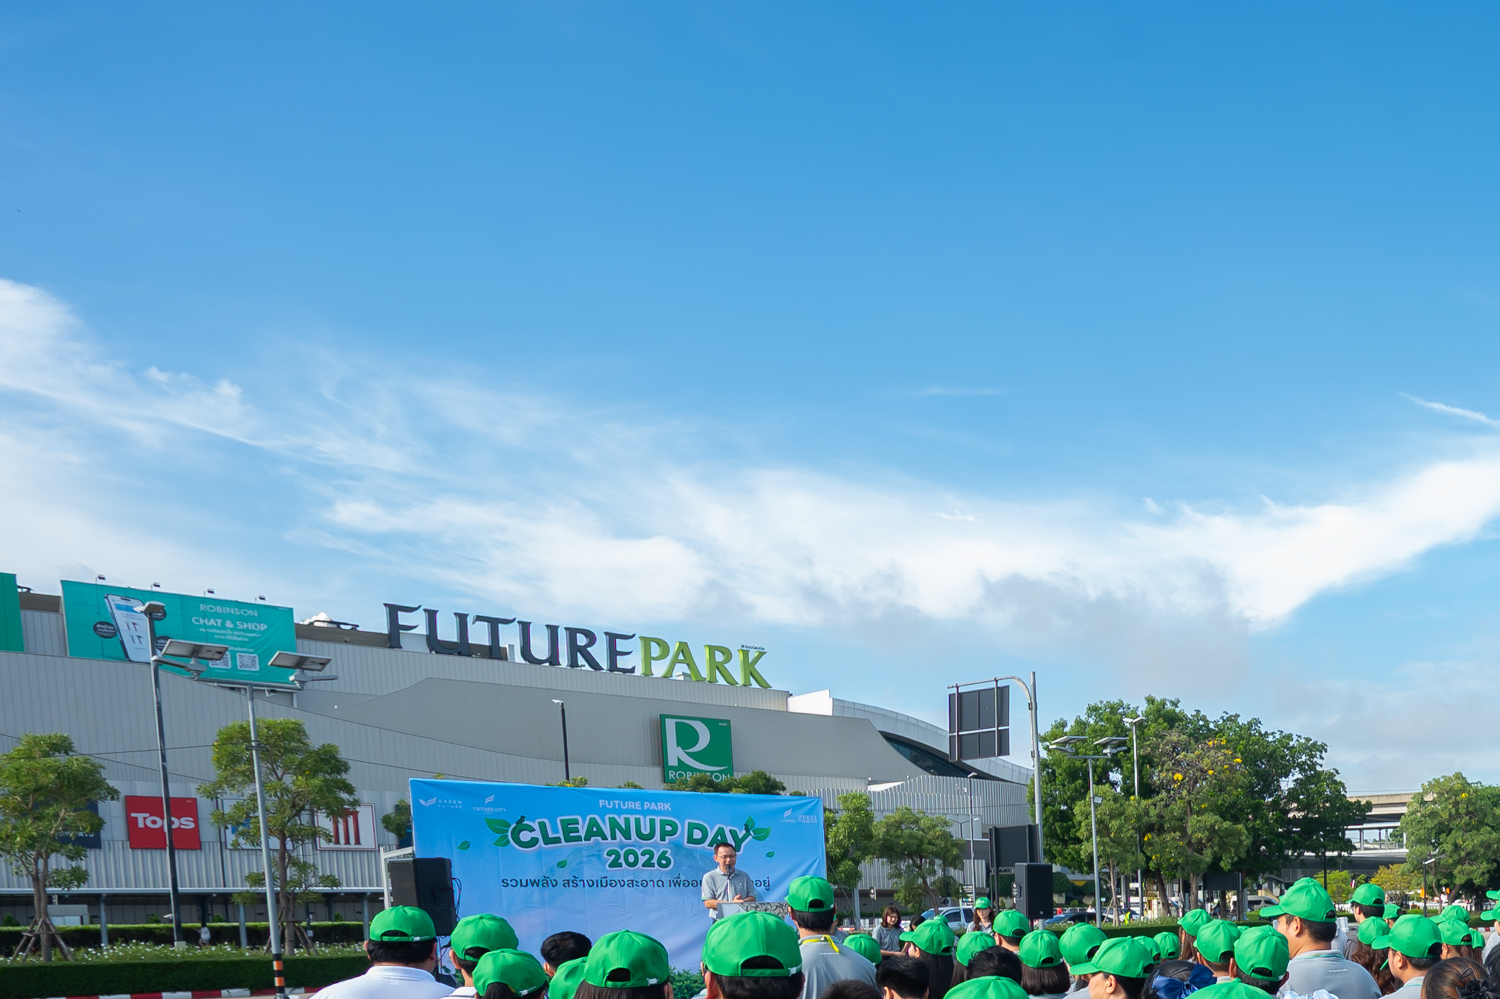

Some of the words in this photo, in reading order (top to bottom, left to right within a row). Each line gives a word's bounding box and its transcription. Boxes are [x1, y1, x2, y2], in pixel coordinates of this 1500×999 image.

[200, 604, 258, 616] ROBINSON
[192, 616, 222, 627] CHAT
[225, 620, 234, 628] &
[236, 621, 267, 631] SHOP
[599, 799, 641, 810] FUTURE
[643, 801, 672, 811] PARK
[510, 815, 678, 849] CLEANUP
[686, 820, 750, 852] DAY
[606, 848, 672, 869] 2026
[501, 875, 558, 888] รวมพลัง
[562, 875, 665, 888] สร้างเมืองสะอาด
